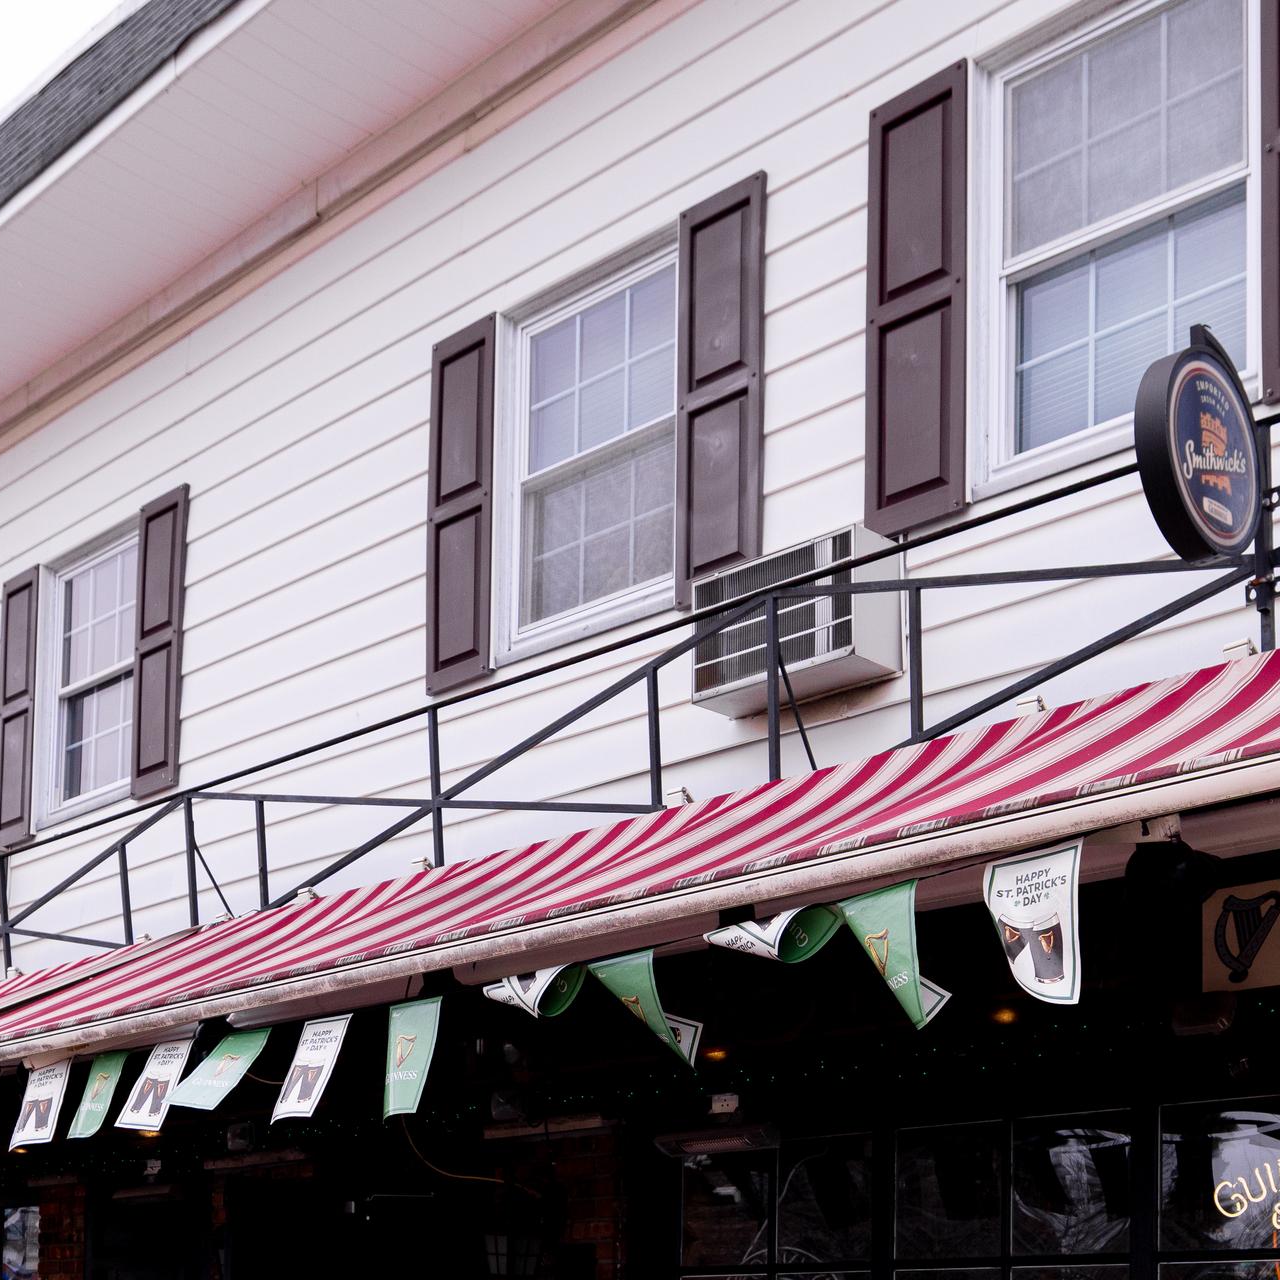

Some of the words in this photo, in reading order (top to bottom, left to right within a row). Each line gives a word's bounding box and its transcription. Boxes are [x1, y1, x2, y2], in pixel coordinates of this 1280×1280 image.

[1183, 439, 1246, 479] Smithwick's
[1016, 868, 1051, 885] HAPPY
[996, 889, 1014, 898] ST.
[1016, 875, 1067, 897] PATRICK'S
[1022, 892, 1043, 907] DAY
[309, 1035, 338, 1044] PATRICK'S
[312, 1029, 333, 1038] HAPPY
